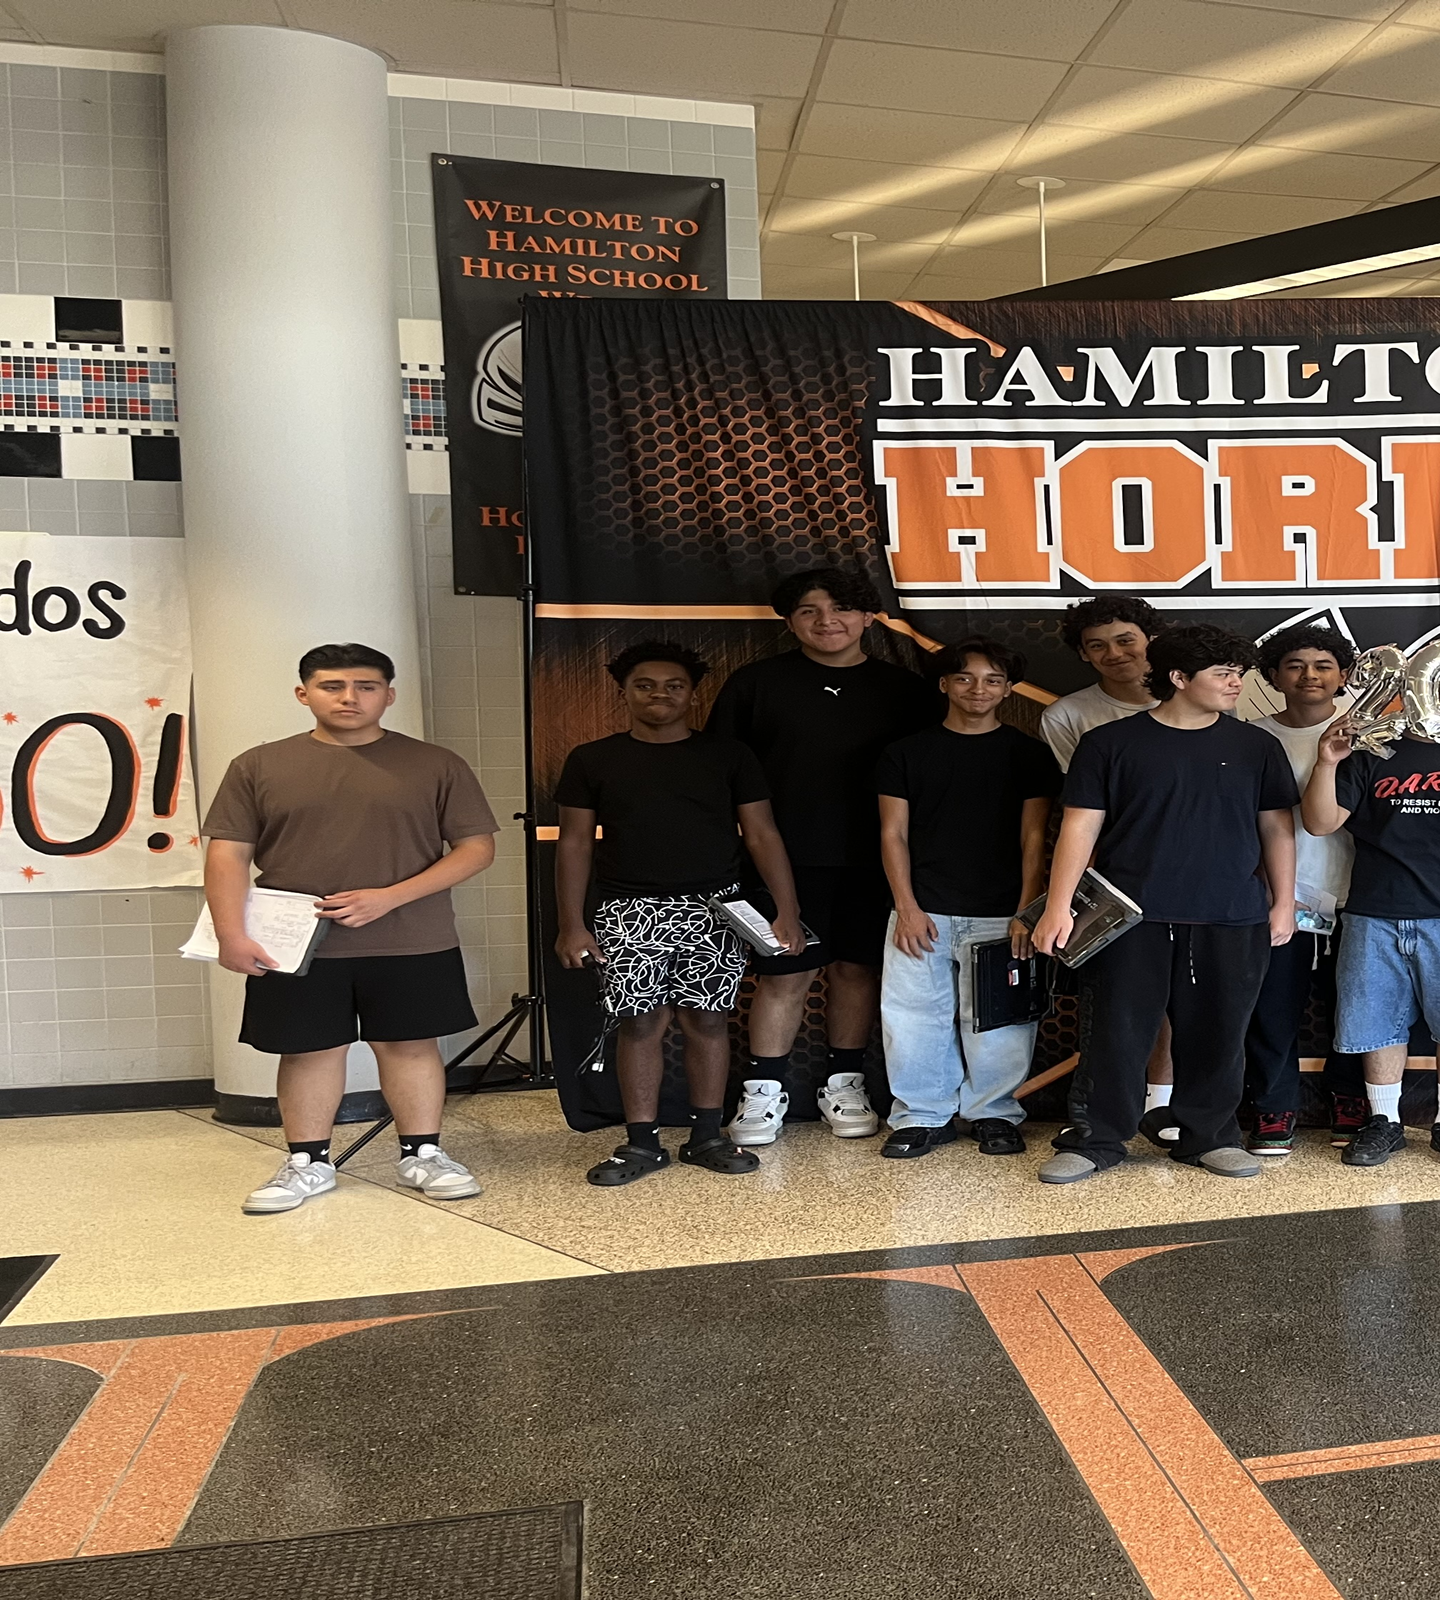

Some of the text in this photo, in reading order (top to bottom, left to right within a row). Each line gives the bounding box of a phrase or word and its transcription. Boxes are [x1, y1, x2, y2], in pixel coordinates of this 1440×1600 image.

[464, 199, 699, 236] WELCOME TO
[486, 229, 681, 263] HAMILTON
[460, 256, 709, 292] HIGH SCHOOL
